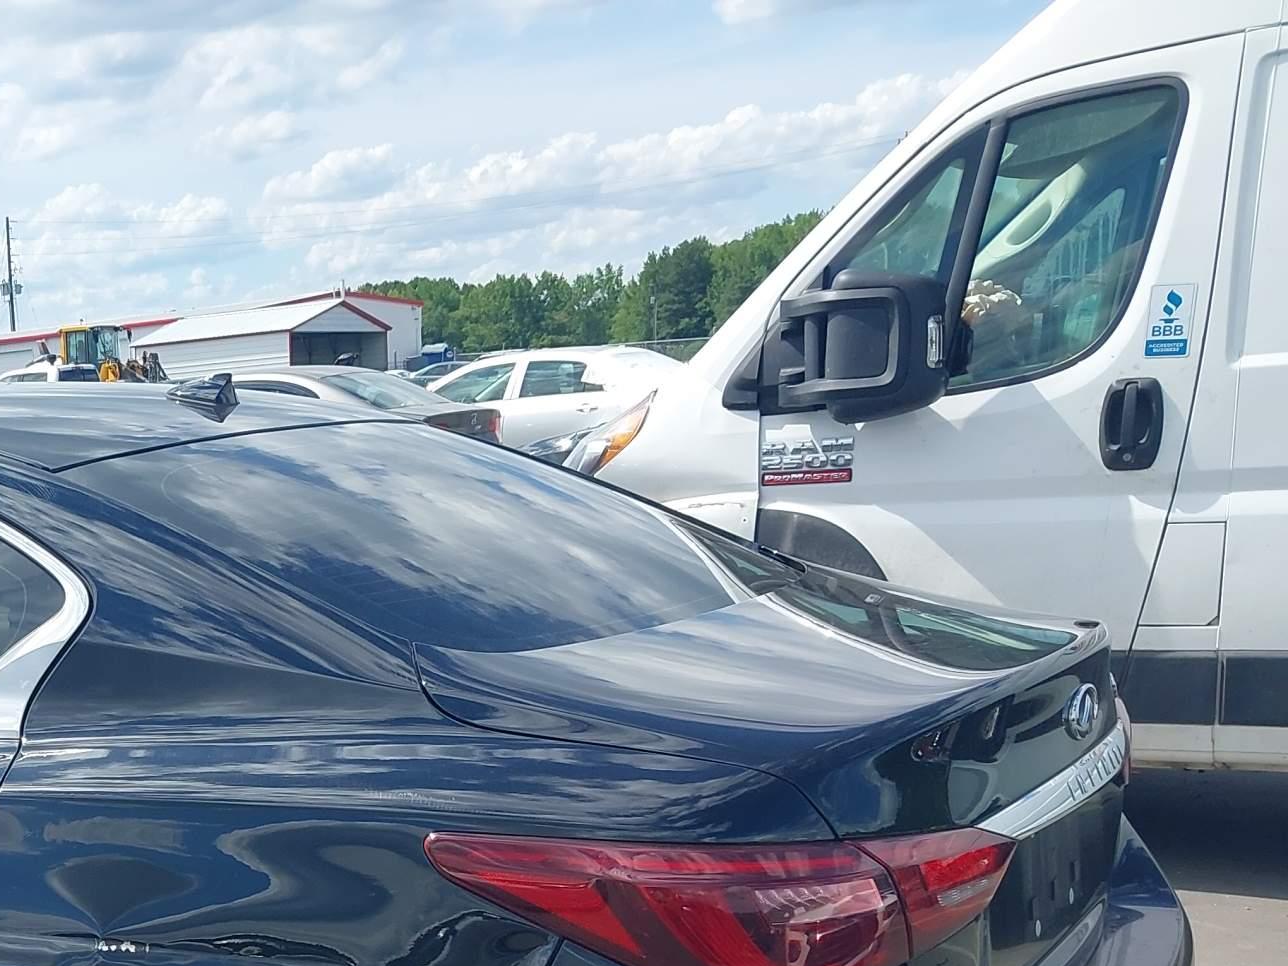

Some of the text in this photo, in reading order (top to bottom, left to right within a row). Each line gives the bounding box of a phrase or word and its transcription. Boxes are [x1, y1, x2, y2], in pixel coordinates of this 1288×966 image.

[1152, 325, 1184, 337] BBB
[762, 437, 854, 455] RAM
[762, 453, 853, 470] 2500
